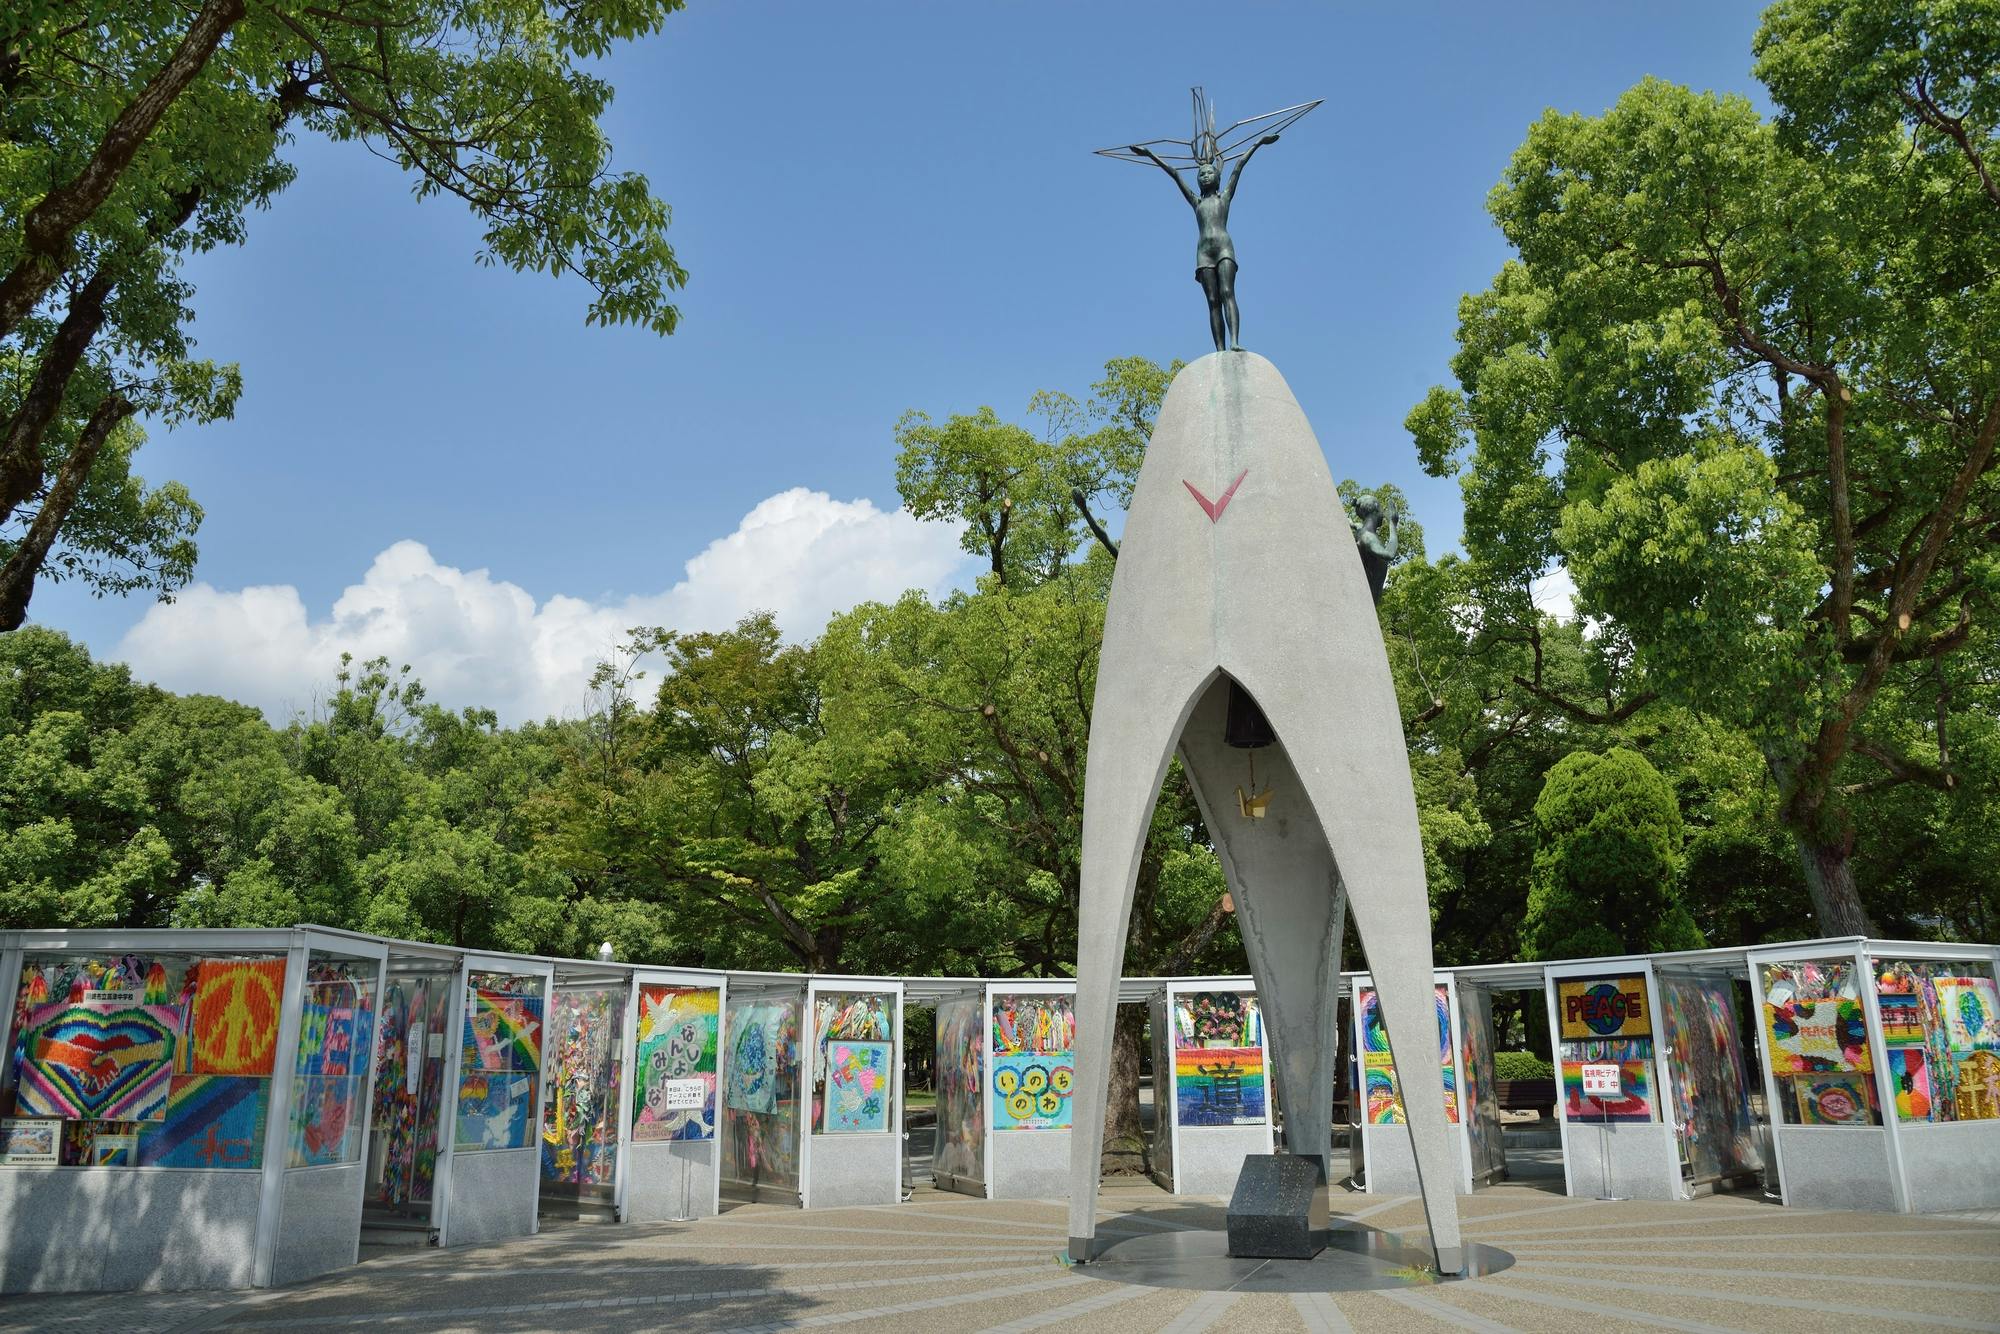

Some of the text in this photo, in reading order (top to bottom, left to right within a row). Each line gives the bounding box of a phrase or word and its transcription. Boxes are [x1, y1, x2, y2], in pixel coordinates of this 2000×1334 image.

[1566, 991, 1642, 1023] PEACE
[653, 1025, 695, 1069] みんな
[1001, 1073, 1069, 1088] いのち
